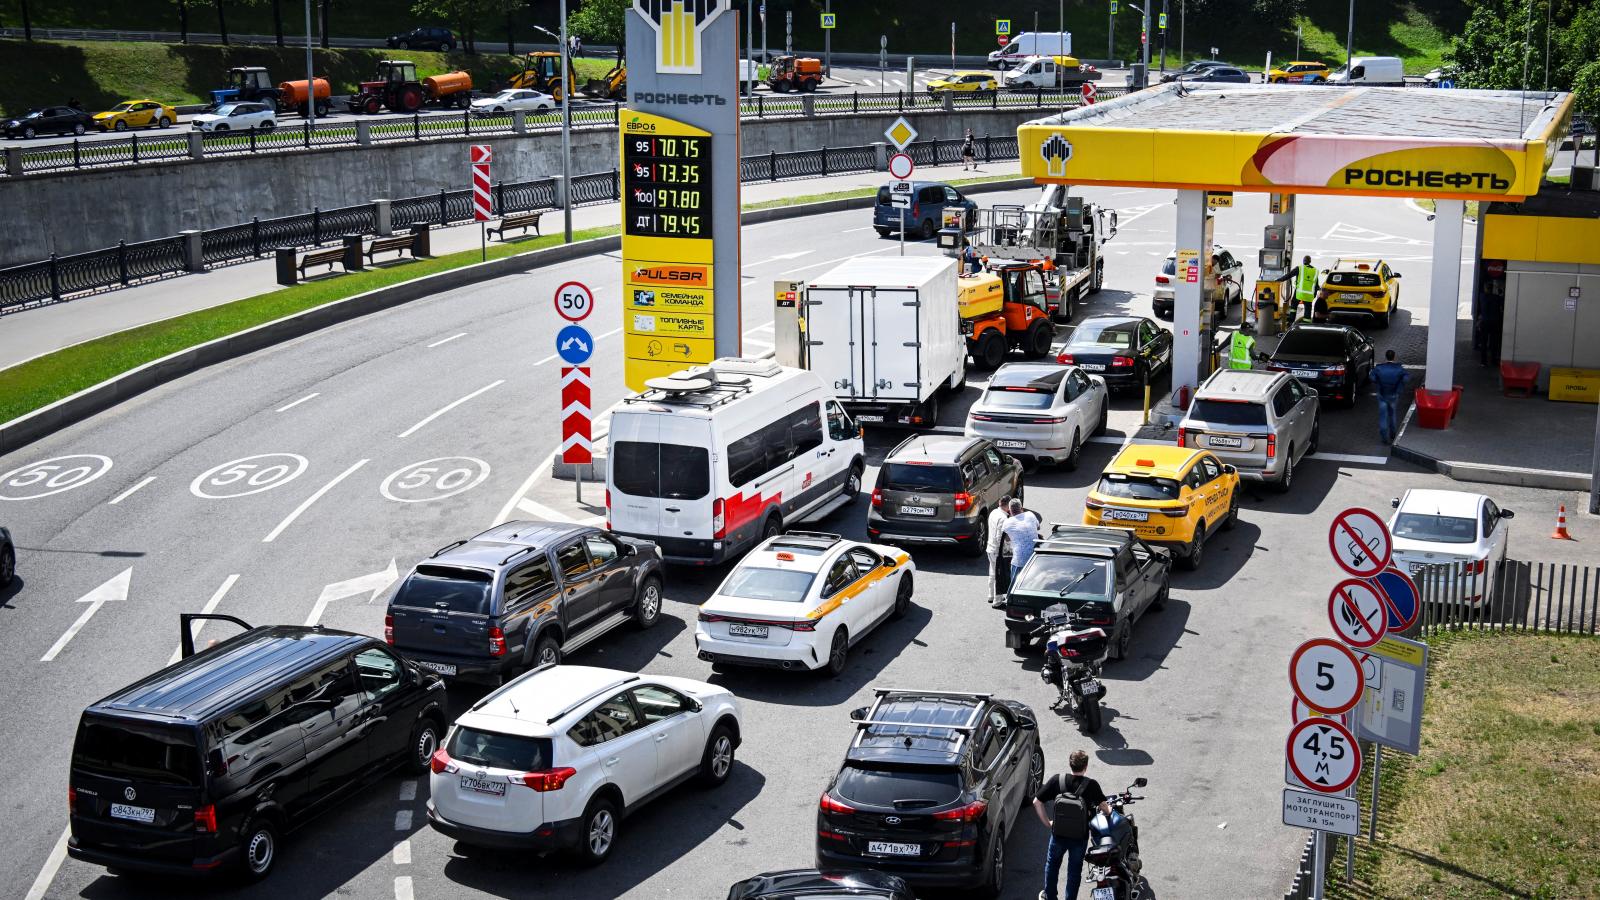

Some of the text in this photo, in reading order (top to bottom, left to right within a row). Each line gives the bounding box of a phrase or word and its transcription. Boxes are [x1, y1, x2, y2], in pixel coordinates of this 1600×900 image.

[634, 92, 727, 105] РОСНЕФТЬ
[627, 122, 649, 130] ЕВРО
[636, 138, 699, 158] 95 70.75
[636, 164, 699, 183] 95 73.35
[1345, 168, 1510, 190] РОСНЕФТЬ
[636, 190, 700, 209] 100 97.80
[636, 214, 700, 234] ДТ 79.45
[637, 269, 703, 281] PULSAR
[563, 293, 585, 309] 50
[660, 292, 704, 300] СЕМЕЙНАЯ
[664, 298, 704, 306] КОМАНДА
[660, 317, 704, 325] ТОПЛИВНЫЕ
[678, 323, 704, 331] КАРТЫ
[9, 465, 92, 487] 50
[210, 464, 289, 486] 50
[398, 467, 472, 490] 50
[1315, 661, 1335, 691] 5
[1303, 732, 1345, 760] 4,5
[1296, 796, 1346, 811] ЗАГЛУШИТЬ
[1285, 804, 1356, 822] МОТОТРАНСПОРТ
[1307, 816, 1317, 824] ЗА
